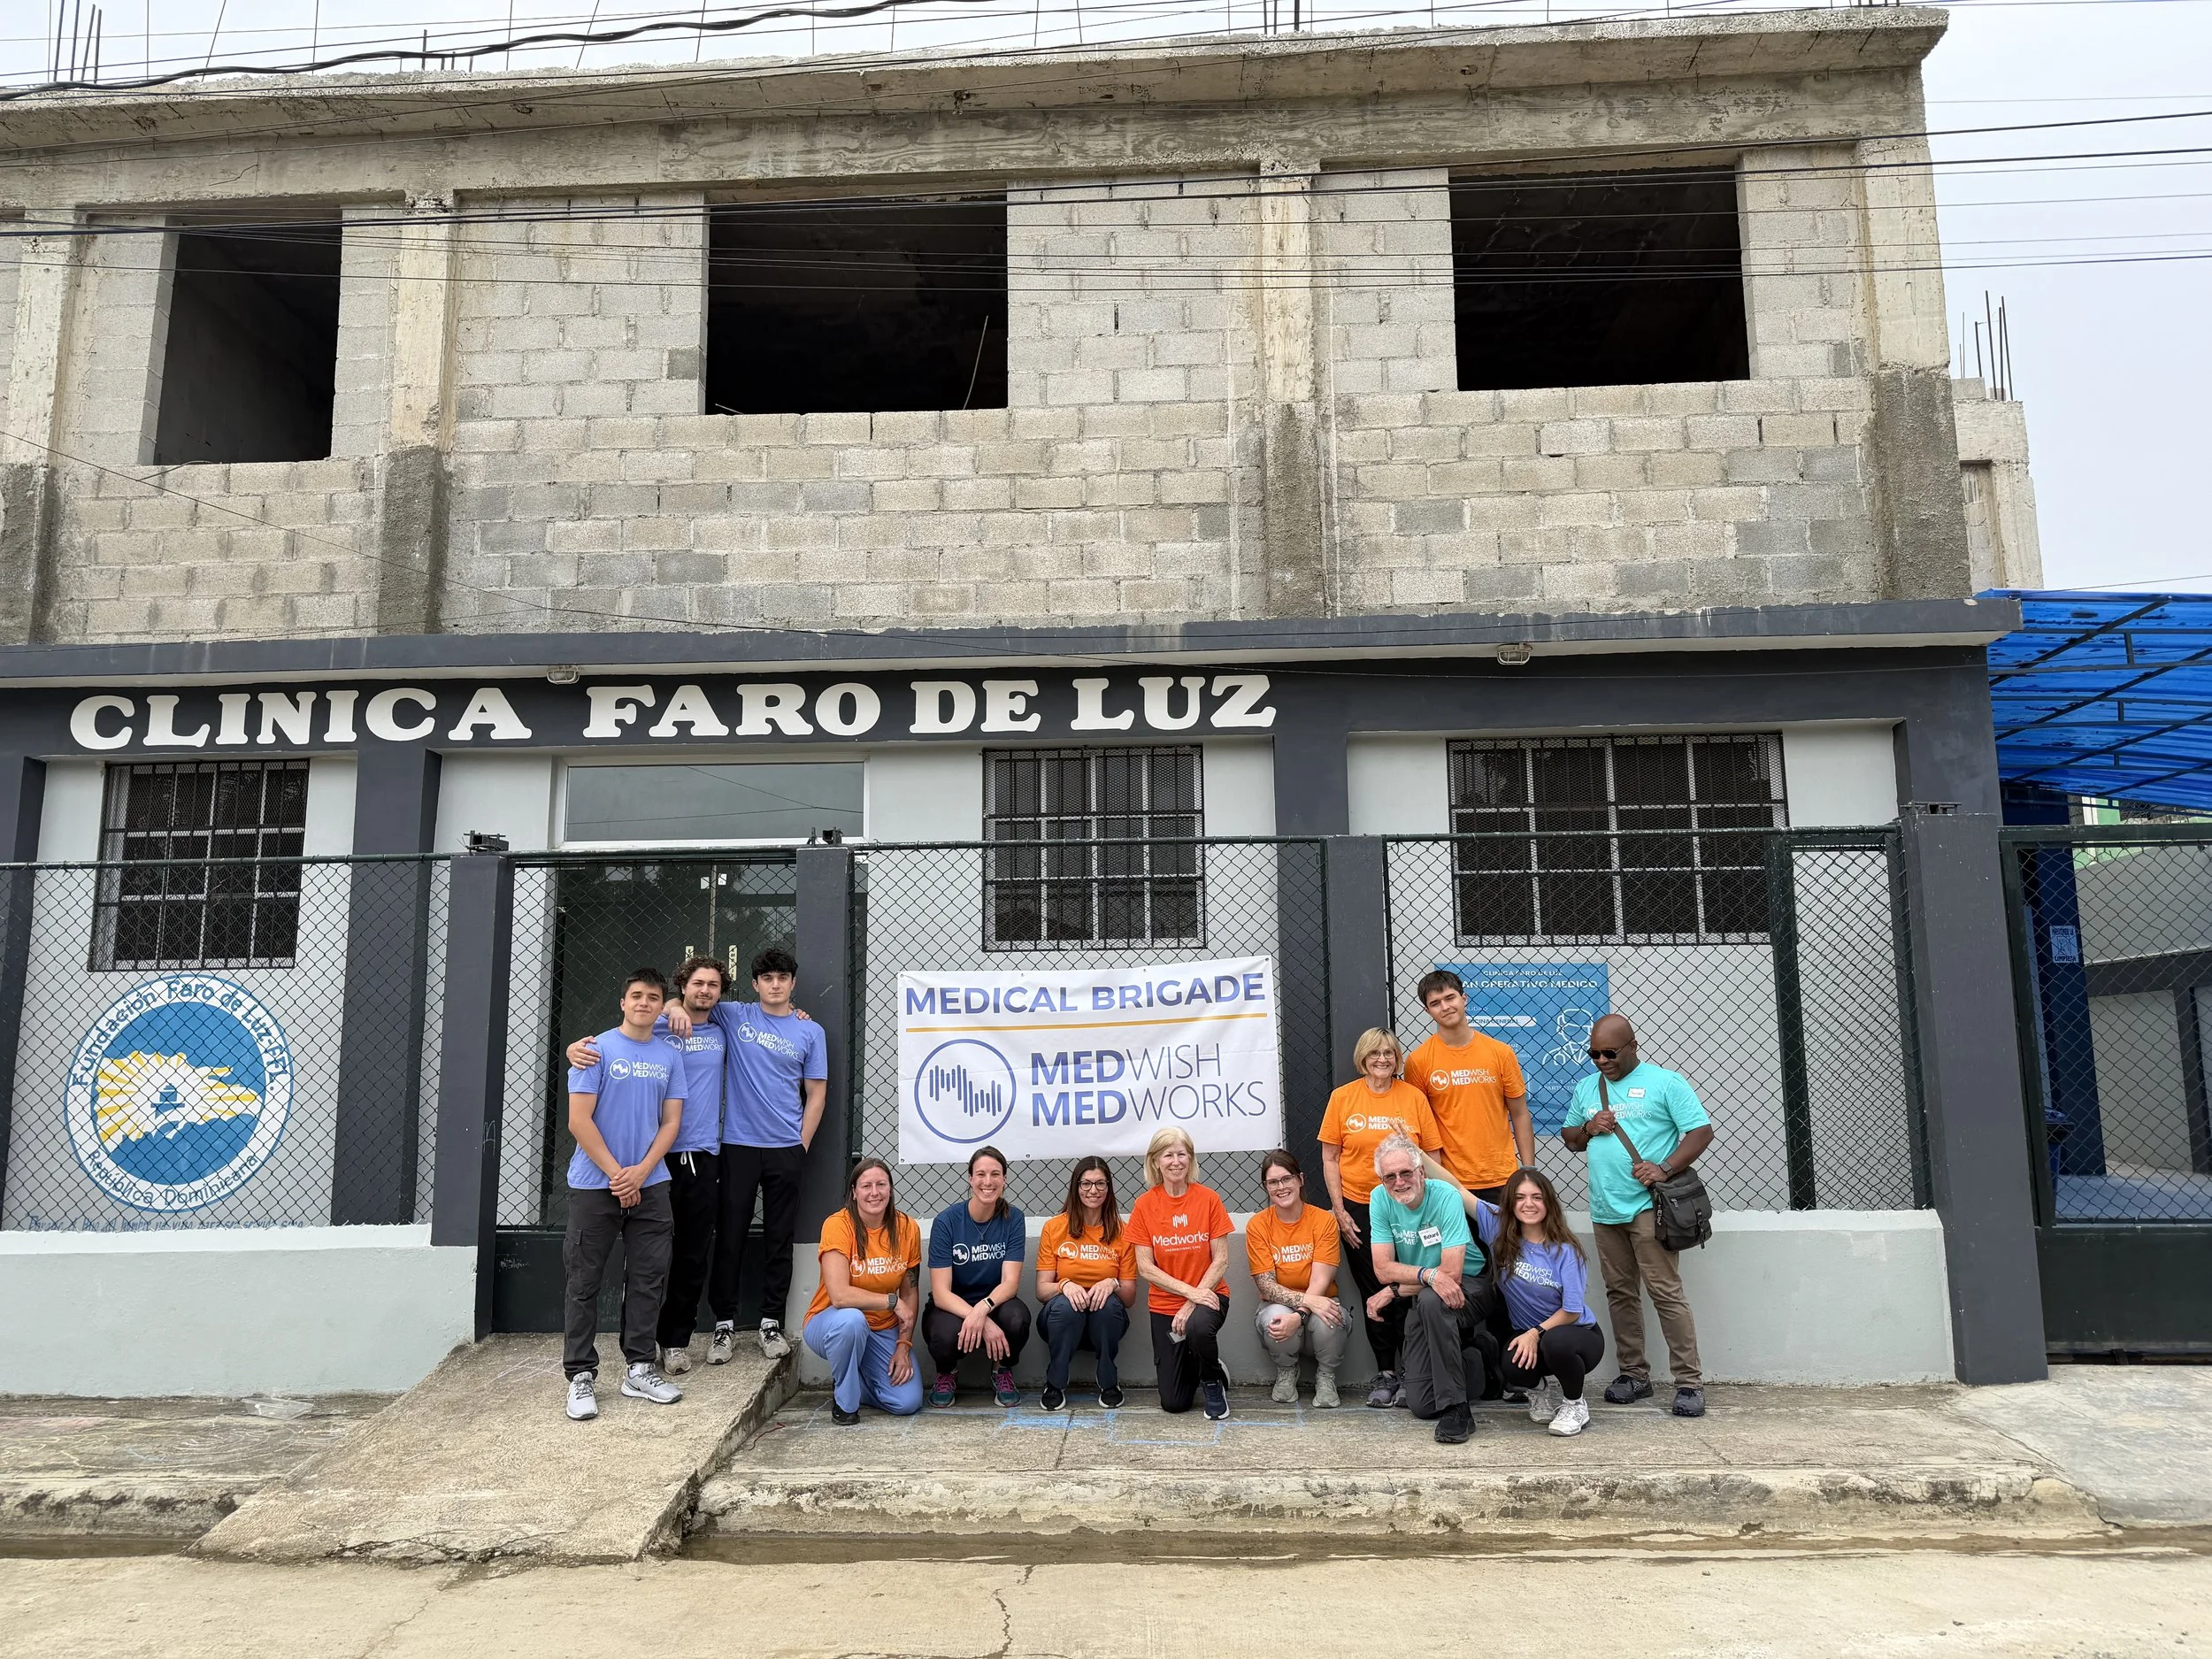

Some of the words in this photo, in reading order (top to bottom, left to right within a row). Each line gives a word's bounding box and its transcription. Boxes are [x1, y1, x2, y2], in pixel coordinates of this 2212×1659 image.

[70, 687, 532, 749] CLINICA
[582, 683, 881, 738] FARO
[909, 680, 1041, 733] DE
[1070, 675, 1276, 731] LUZ
[166, 979, 215, 1000] Faro
[220, 989, 242, 1012] de
[905, 986, 1078, 1015] MEDICAL
[1092, 972, 1265, 1010] BRIGADE
[758, 1031, 795, 1049] MEDWISH
[1031, 1043, 1222, 1086] MEDWISH
[1450, 1069, 1489, 1078] MEDWISH
[1451, 1076, 1497, 1086] MEDWORKS
[1032, 1080, 1266, 1127] MEDWORKS
[89, 1151, 155, 1203] República
[165, 1155, 258, 1205] Dominicana
[1152, 1231, 1210, 1247] Medworks
[1281, 1239, 1314, 1249] MEDWIS
[972, 1250, 1006, 1262] MEDWOR
